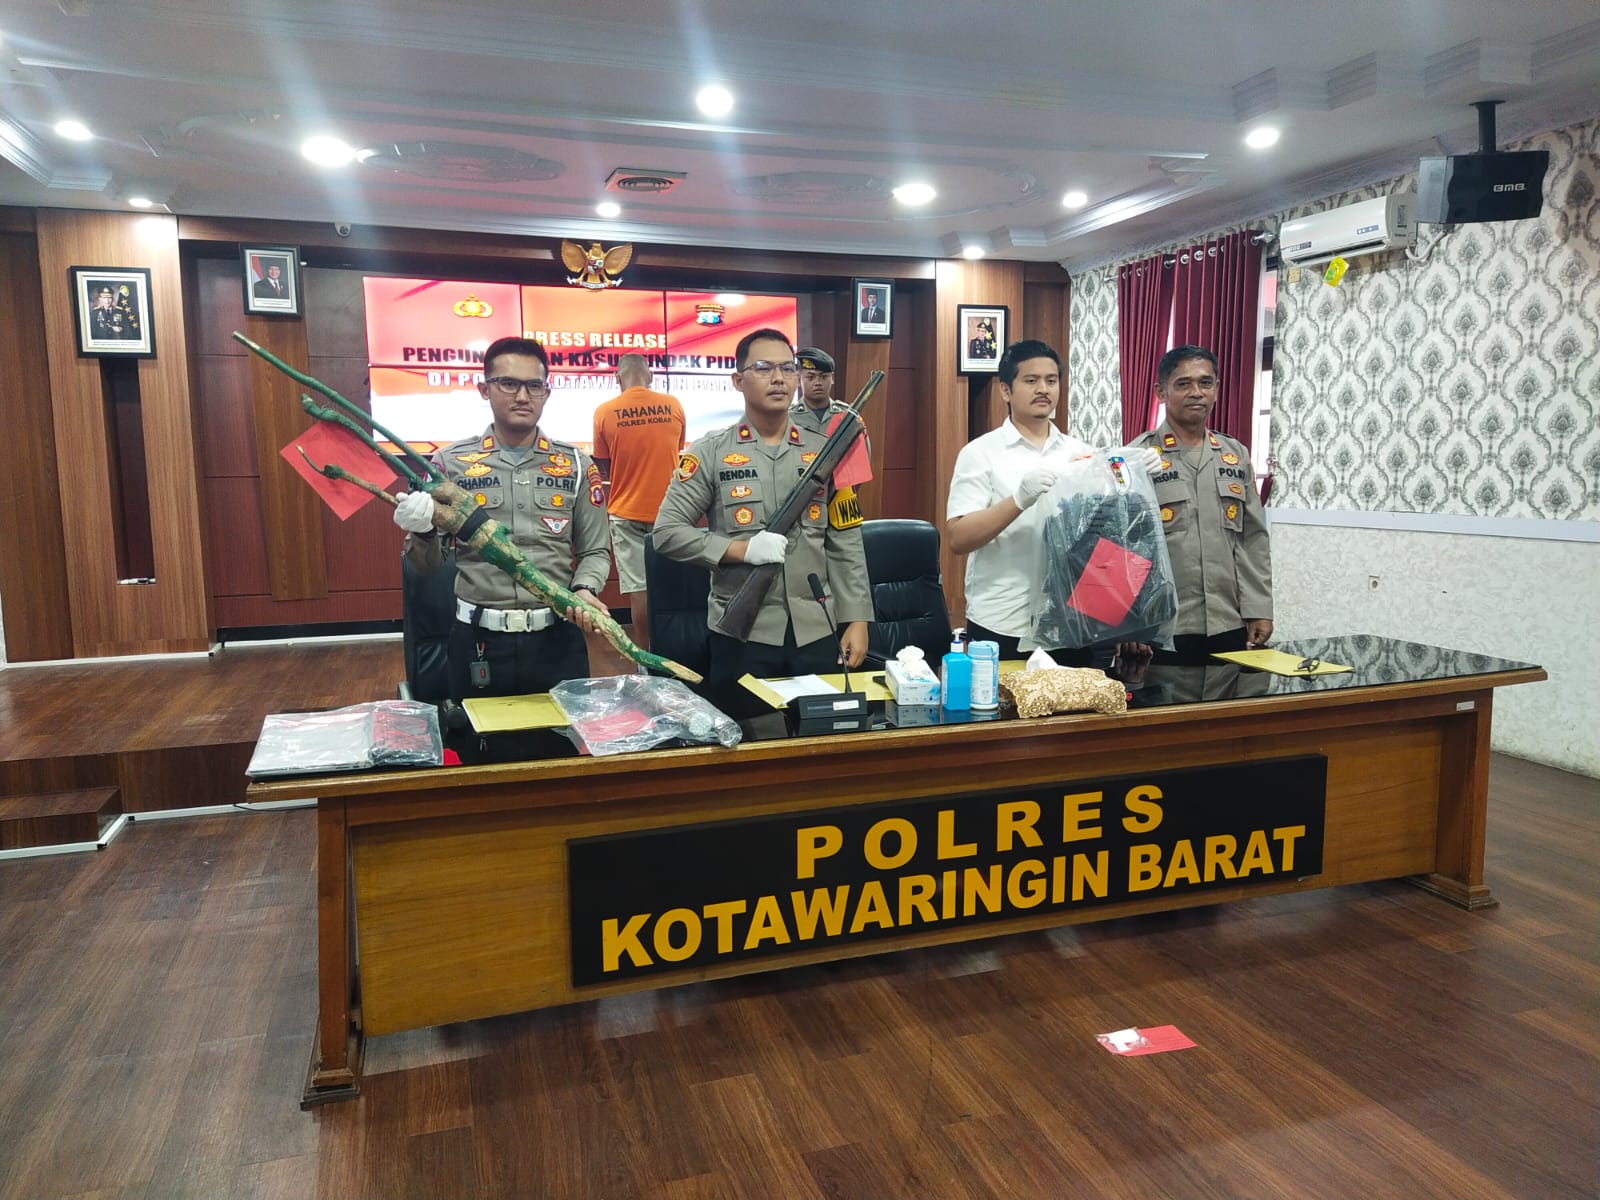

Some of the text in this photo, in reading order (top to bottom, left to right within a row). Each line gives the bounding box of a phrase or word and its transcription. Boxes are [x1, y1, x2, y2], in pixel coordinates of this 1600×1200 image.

[523, 331, 666, 349] PRESS RELEASE
[568, 352, 620, 367] KASU
[428, 371, 451, 386] DI
[614, 404, 672, 419] TAHANAN
[616, 416, 672, 428] POLRES KOBAR
[718, 468, 759, 482] RENDRA
[1218, 467, 1246, 480] POLRI
[456, 476, 501, 491] GHANDA
[536, 476, 575, 491] POLRI
[797, 785, 1164, 879] POLRES
[602, 825, 1306, 972] KOTAWARINGIN BARAT
